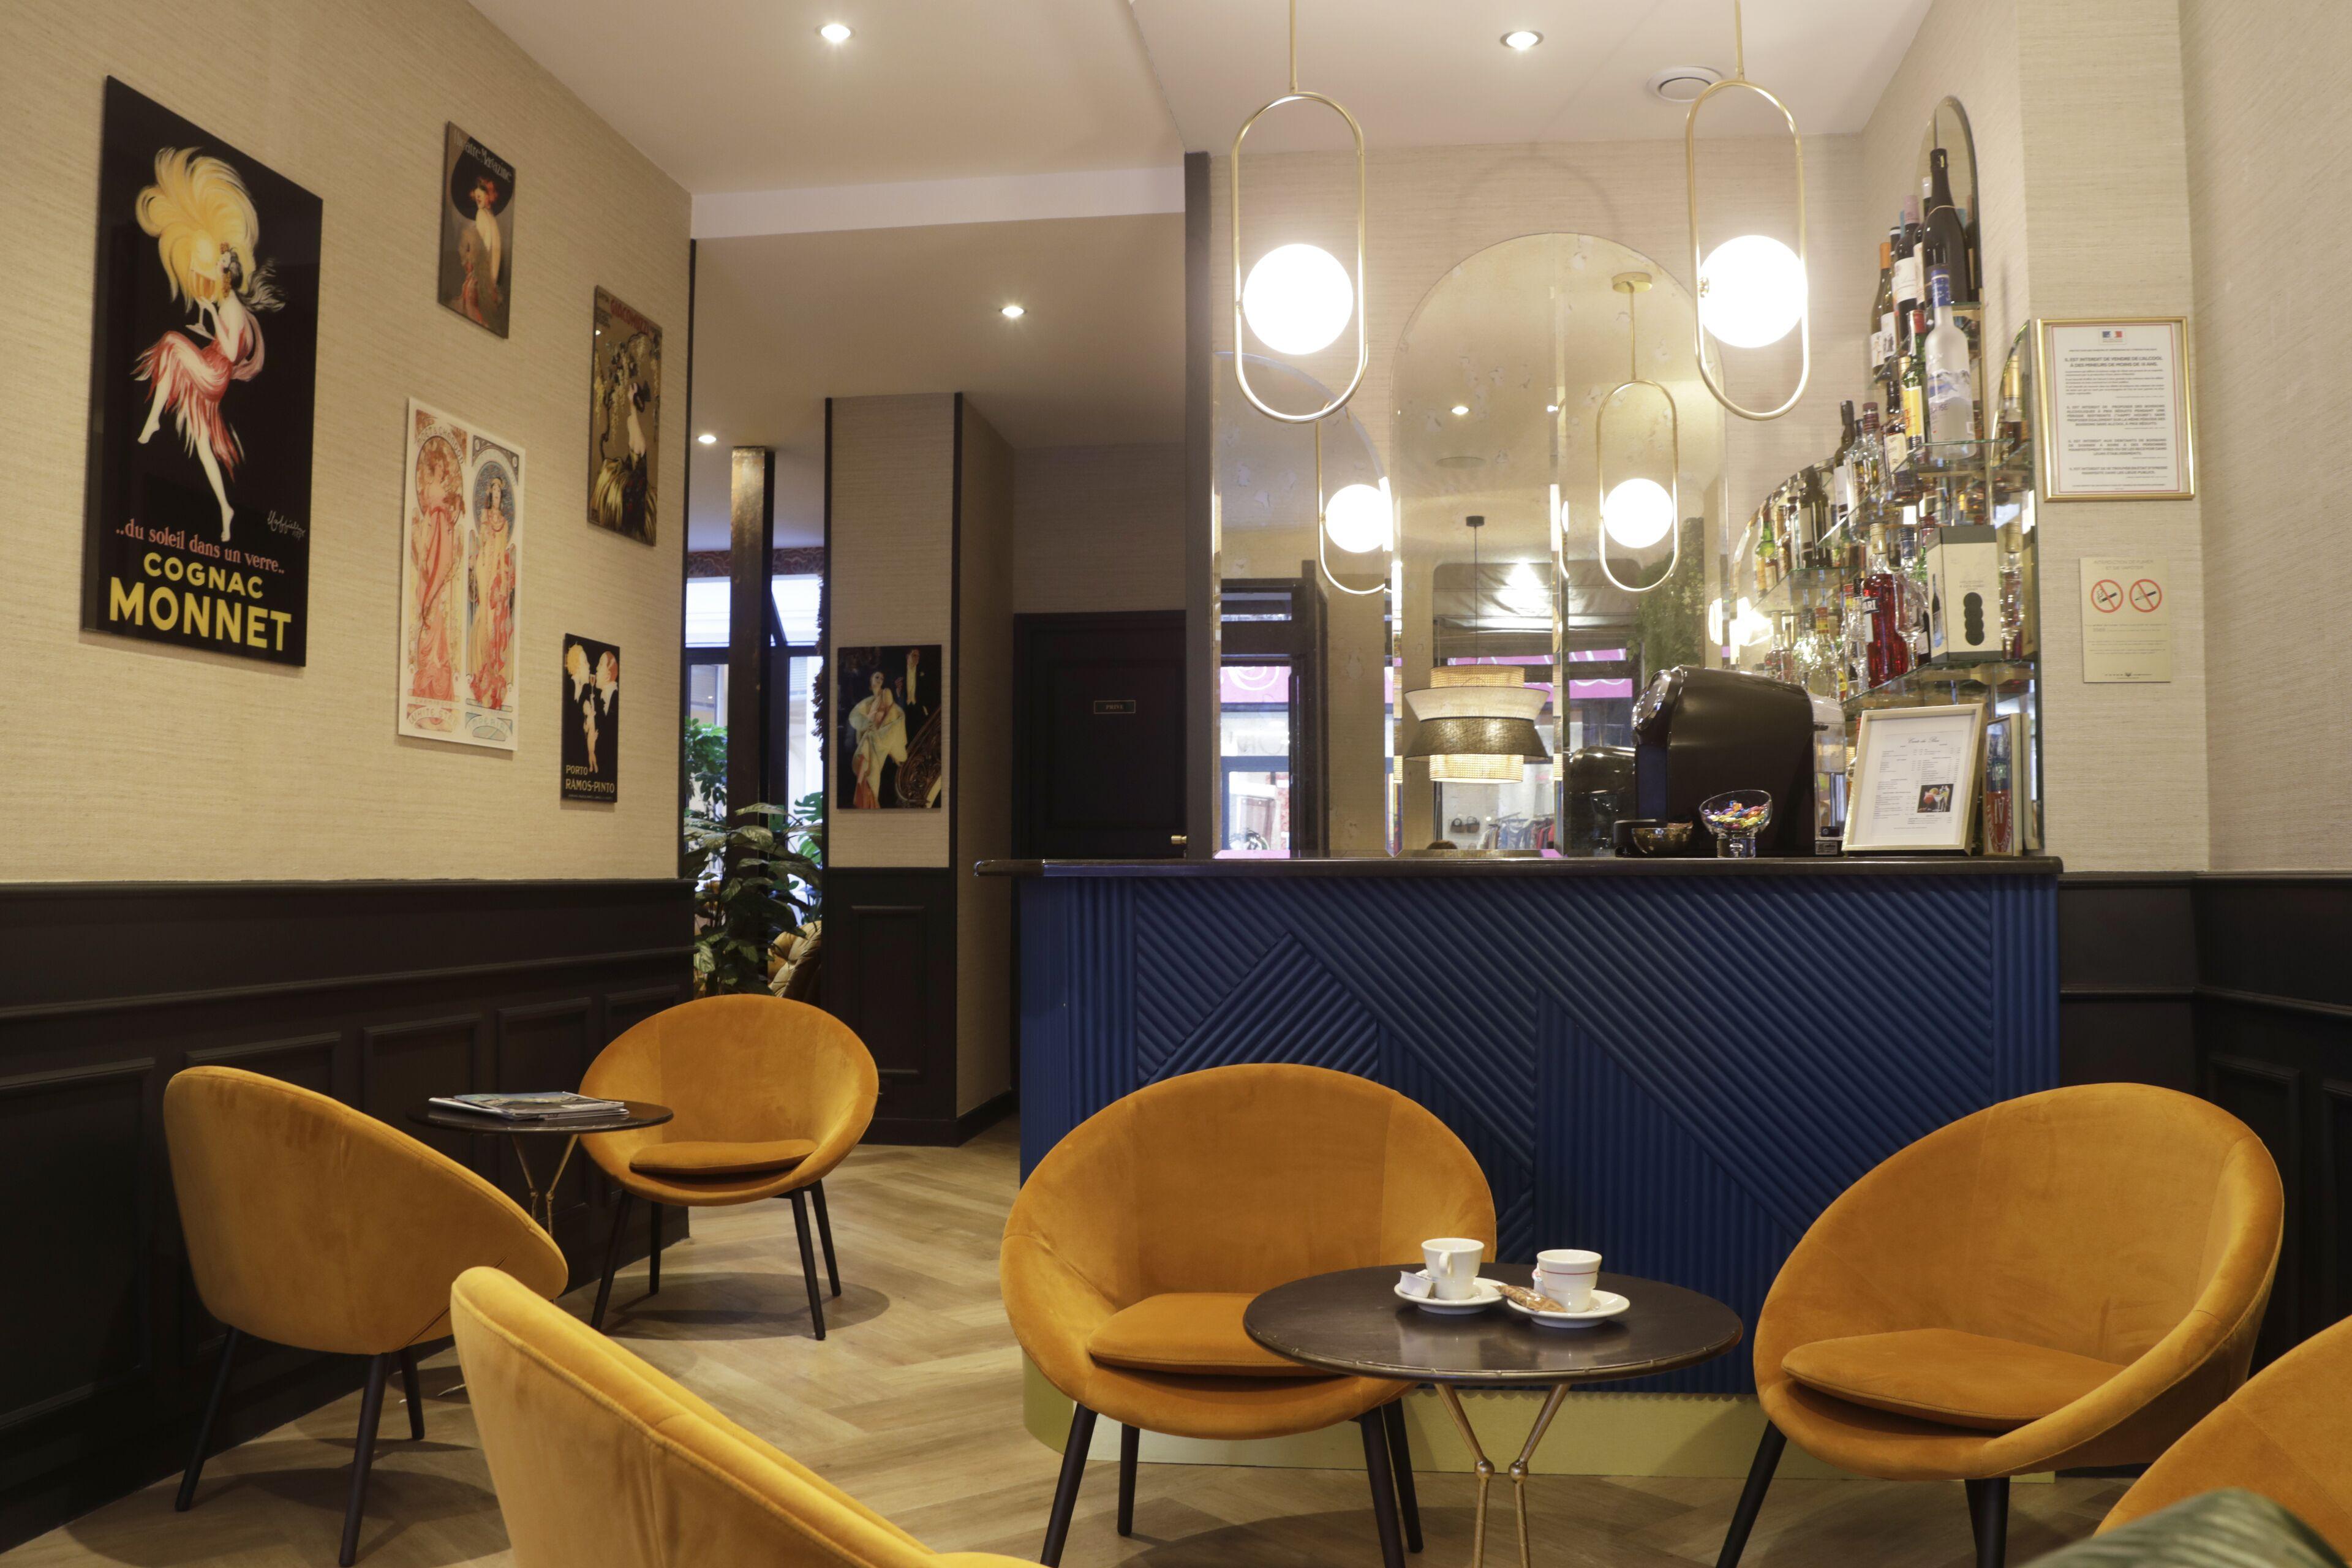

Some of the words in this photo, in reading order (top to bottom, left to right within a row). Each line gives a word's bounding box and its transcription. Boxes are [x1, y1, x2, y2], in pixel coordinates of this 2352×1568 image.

[148, 526, 185, 550] soleil
[189, 534, 221, 558] dans
[224, 548, 241, 564] un
[143, 552, 263, 599] COGNAC
[109, 576, 292, 651] MONNET
[565, 764, 588, 775] PORTO
[565, 778, 615, 794] RAMOS-PINTO
